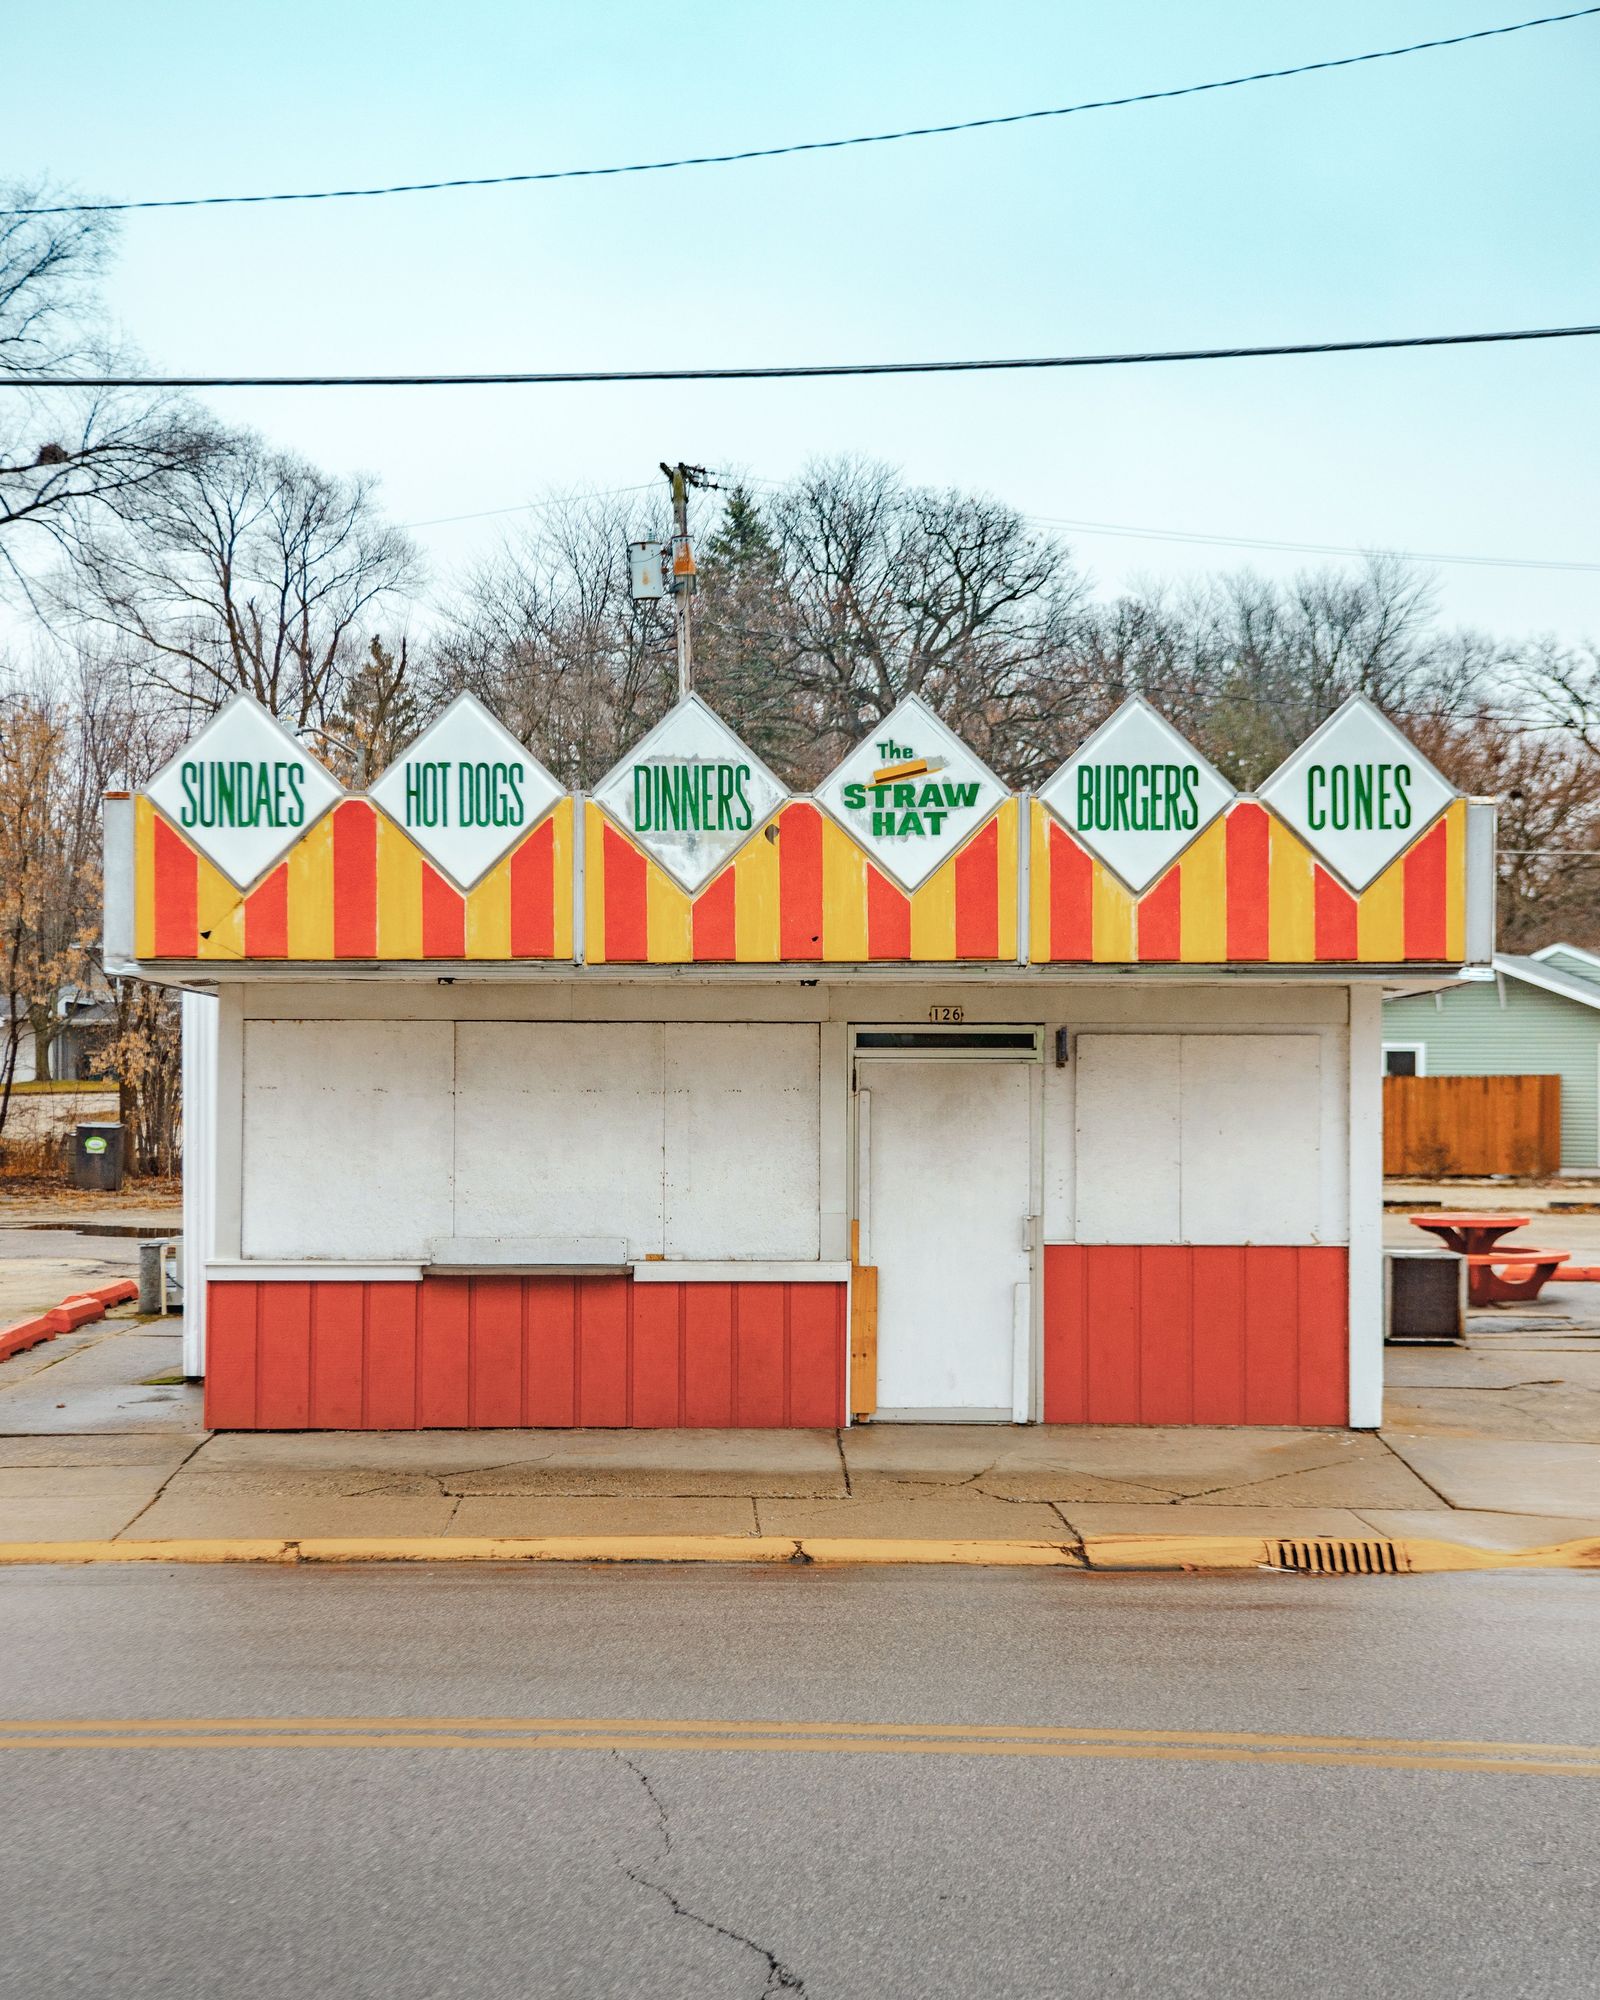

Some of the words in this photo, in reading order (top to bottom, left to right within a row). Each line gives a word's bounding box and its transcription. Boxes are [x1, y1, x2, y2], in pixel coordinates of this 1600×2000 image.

[876, 739, 914, 760] The
[181, 762, 304, 827] SUNDAES
[406, 762, 451, 827] HOT
[459, 762, 524, 827] DOGS
[634, 765, 752, 832] DINNERS
[844, 783, 980, 809] STRAW
[872, 811, 948, 836] HAT
[1078, 765, 1198, 831] BURGERS
[1308, 764, 1411, 830] CONES
[934, 1008, 961, 1021] 126
